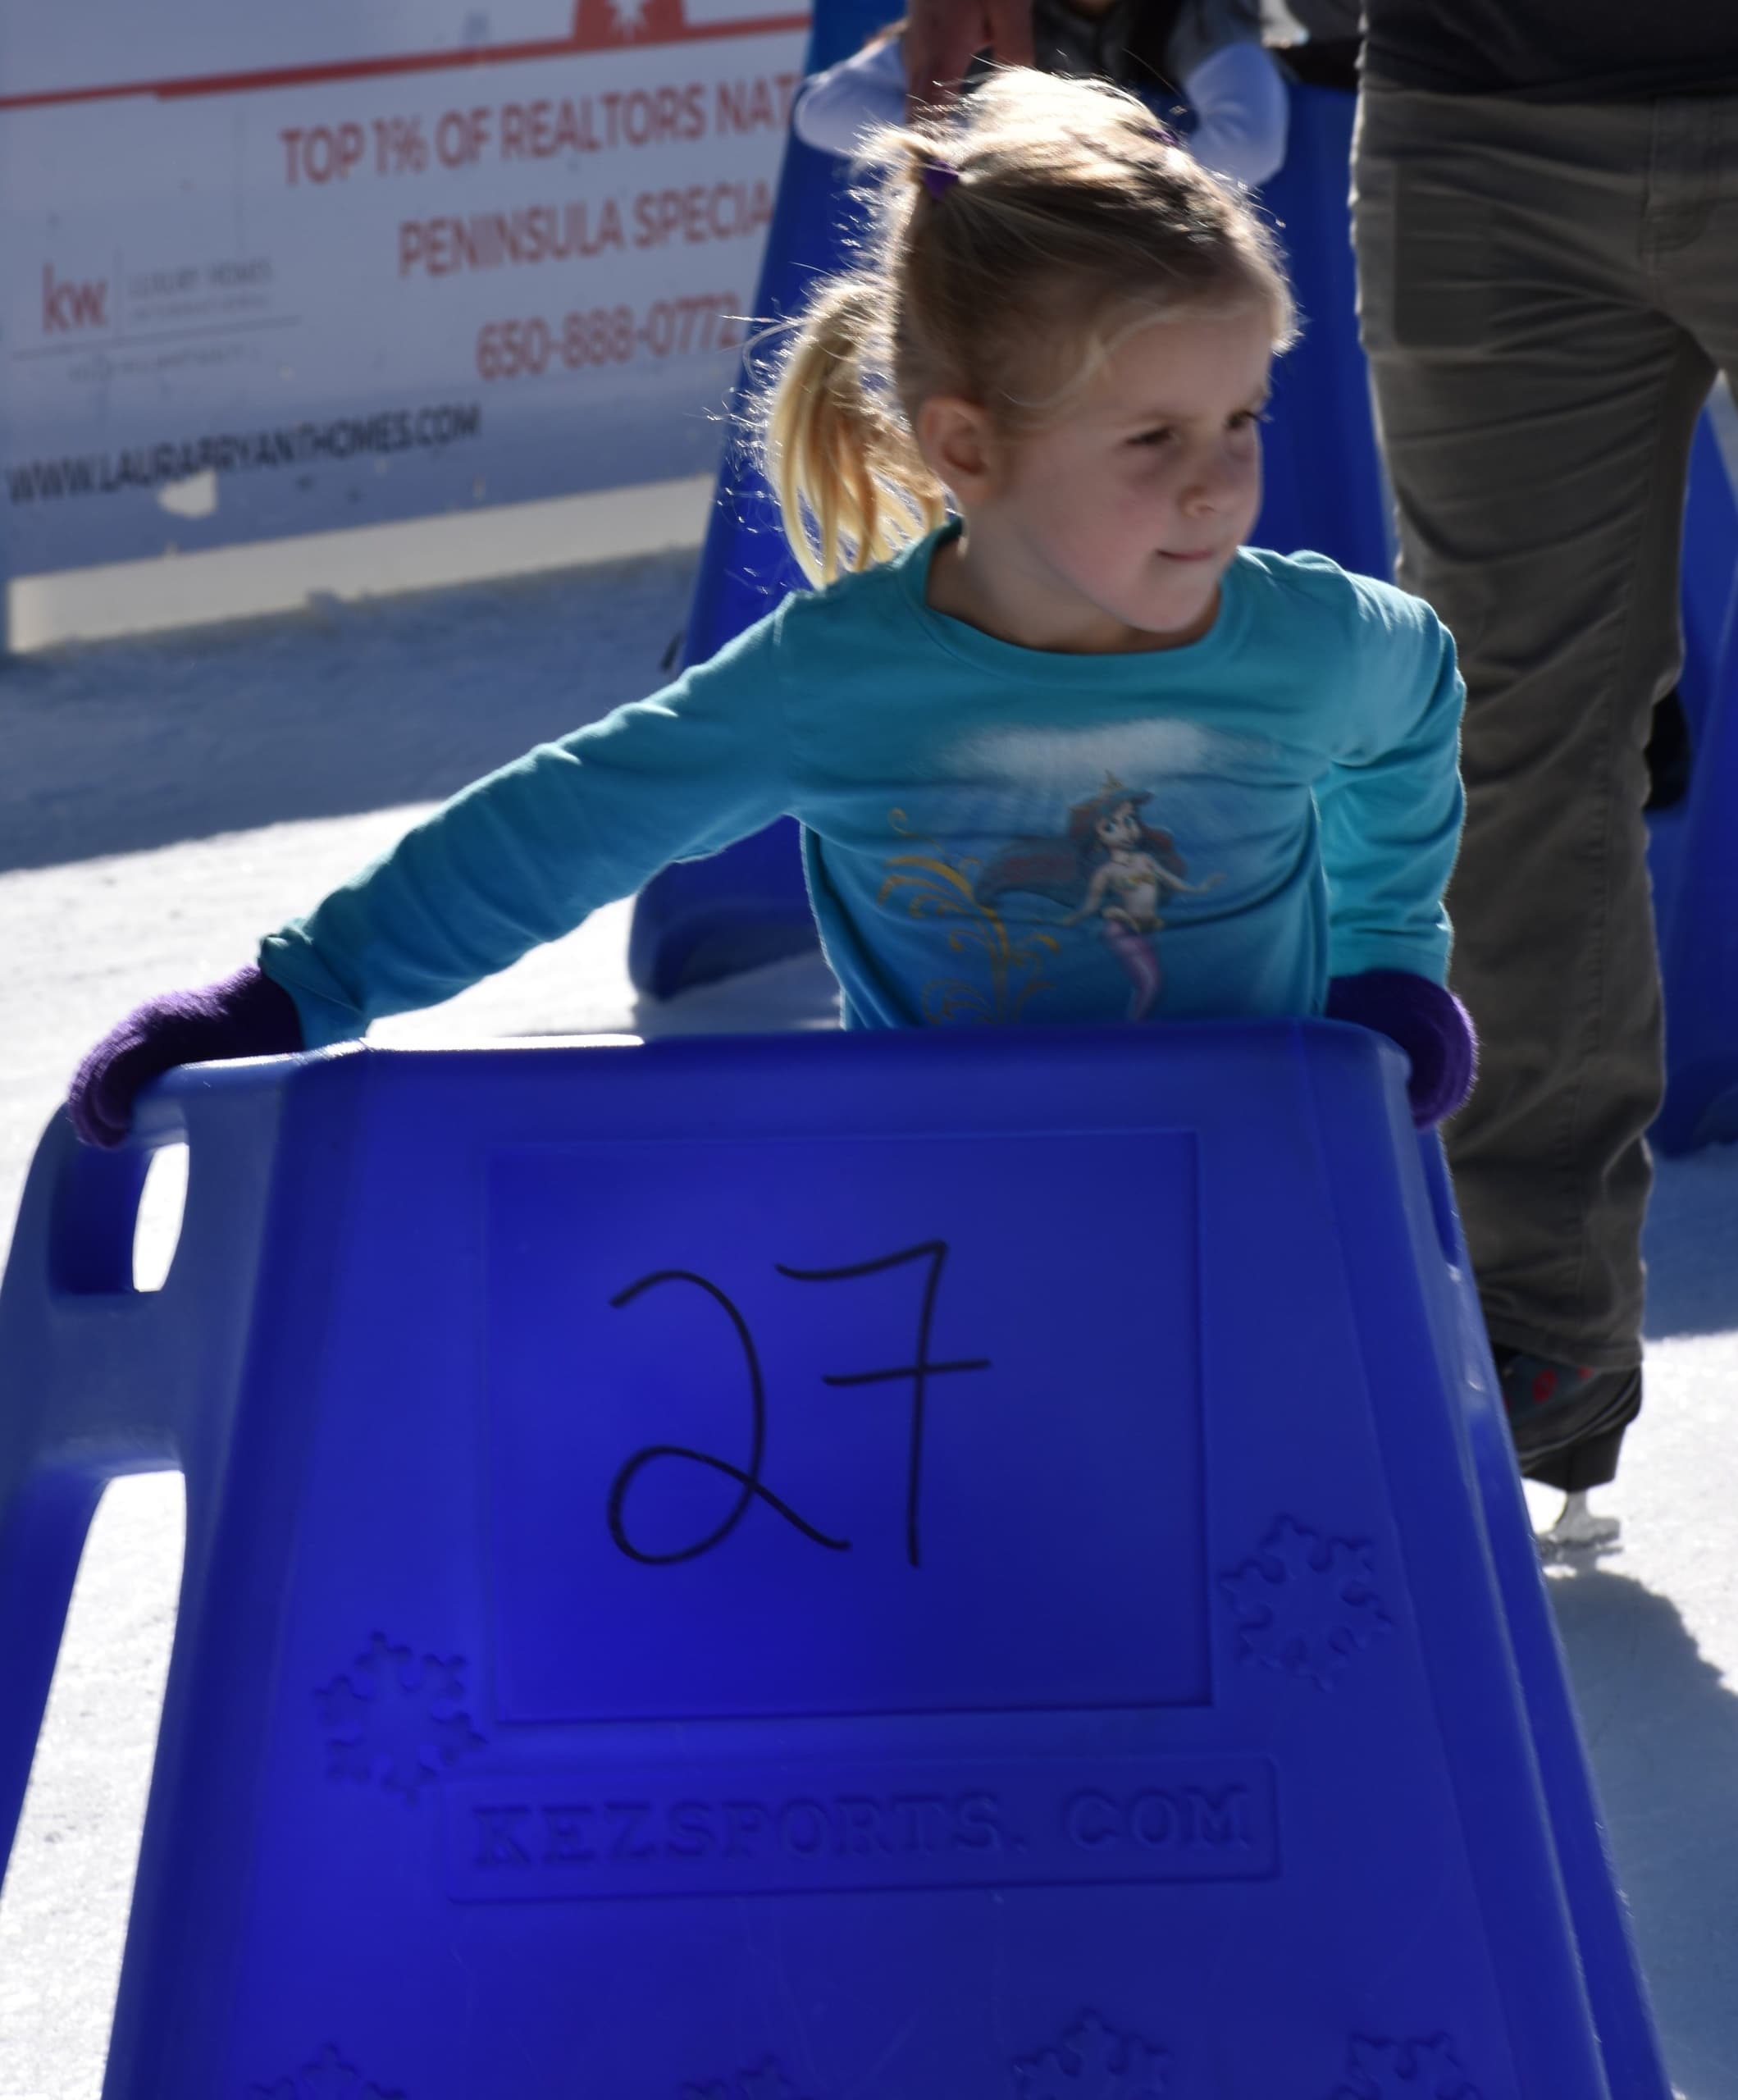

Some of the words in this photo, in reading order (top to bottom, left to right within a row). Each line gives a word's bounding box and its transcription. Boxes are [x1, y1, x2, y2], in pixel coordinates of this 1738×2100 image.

[279, 119, 366, 185] TOP
[371, 114, 431, 176] 1%
[435, 105, 492, 169] OF
[500, 83, 706, 162] REALTORS
[398, 199, 625, 277] PENINSULA
[476, 291, 742, 384] 650-888-0772
[607, 1239, 992, 1568] 27
[1063, 1781, 1253, 1851] COM
